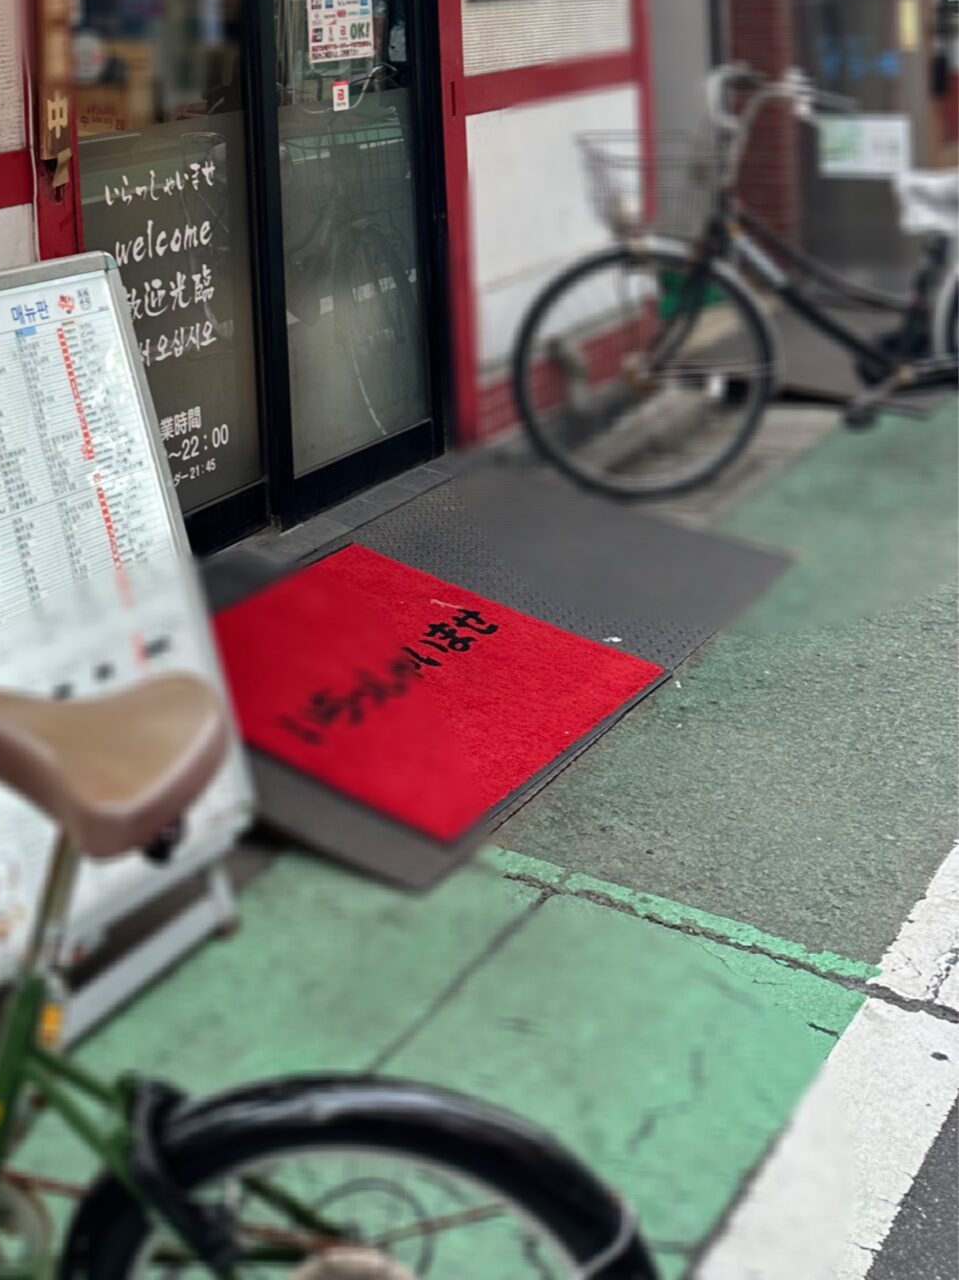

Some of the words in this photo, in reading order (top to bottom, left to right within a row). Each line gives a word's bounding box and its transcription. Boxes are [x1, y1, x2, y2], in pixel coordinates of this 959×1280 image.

[104, 160, 217, 207] いらっしゃいませ
[114, 219, 214, 268] welcome
[155, 320, 218, 364] 오십시오
